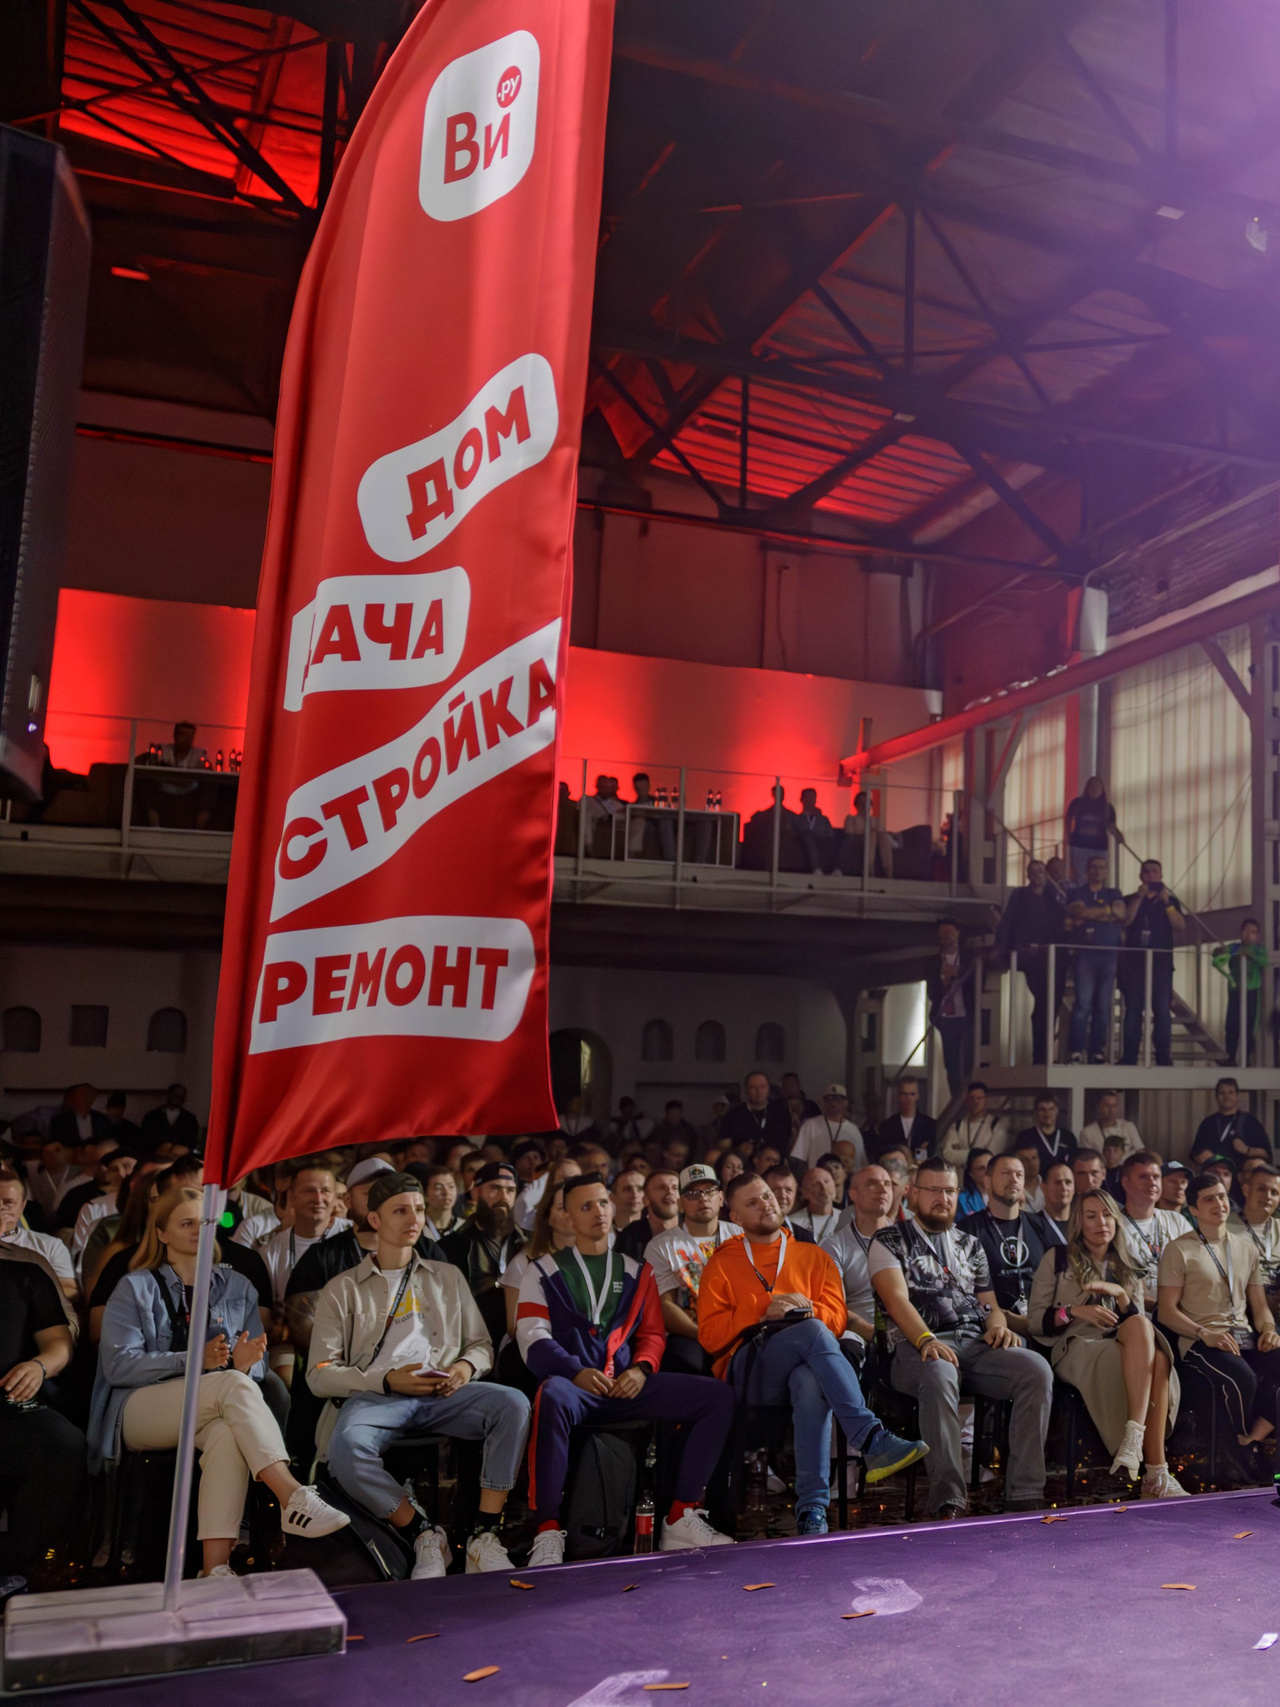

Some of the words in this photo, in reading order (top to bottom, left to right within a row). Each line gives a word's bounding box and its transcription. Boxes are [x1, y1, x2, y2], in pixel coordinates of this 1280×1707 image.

[443, 112, 511, 184] Ви
[406, 385, 531, 541] ДОМ
[301, 598, 444, 693] АЧА
[278, 657, 557, 880] СТРОЙКА
[259, 944, 508, 1024] РЕМОНТ
